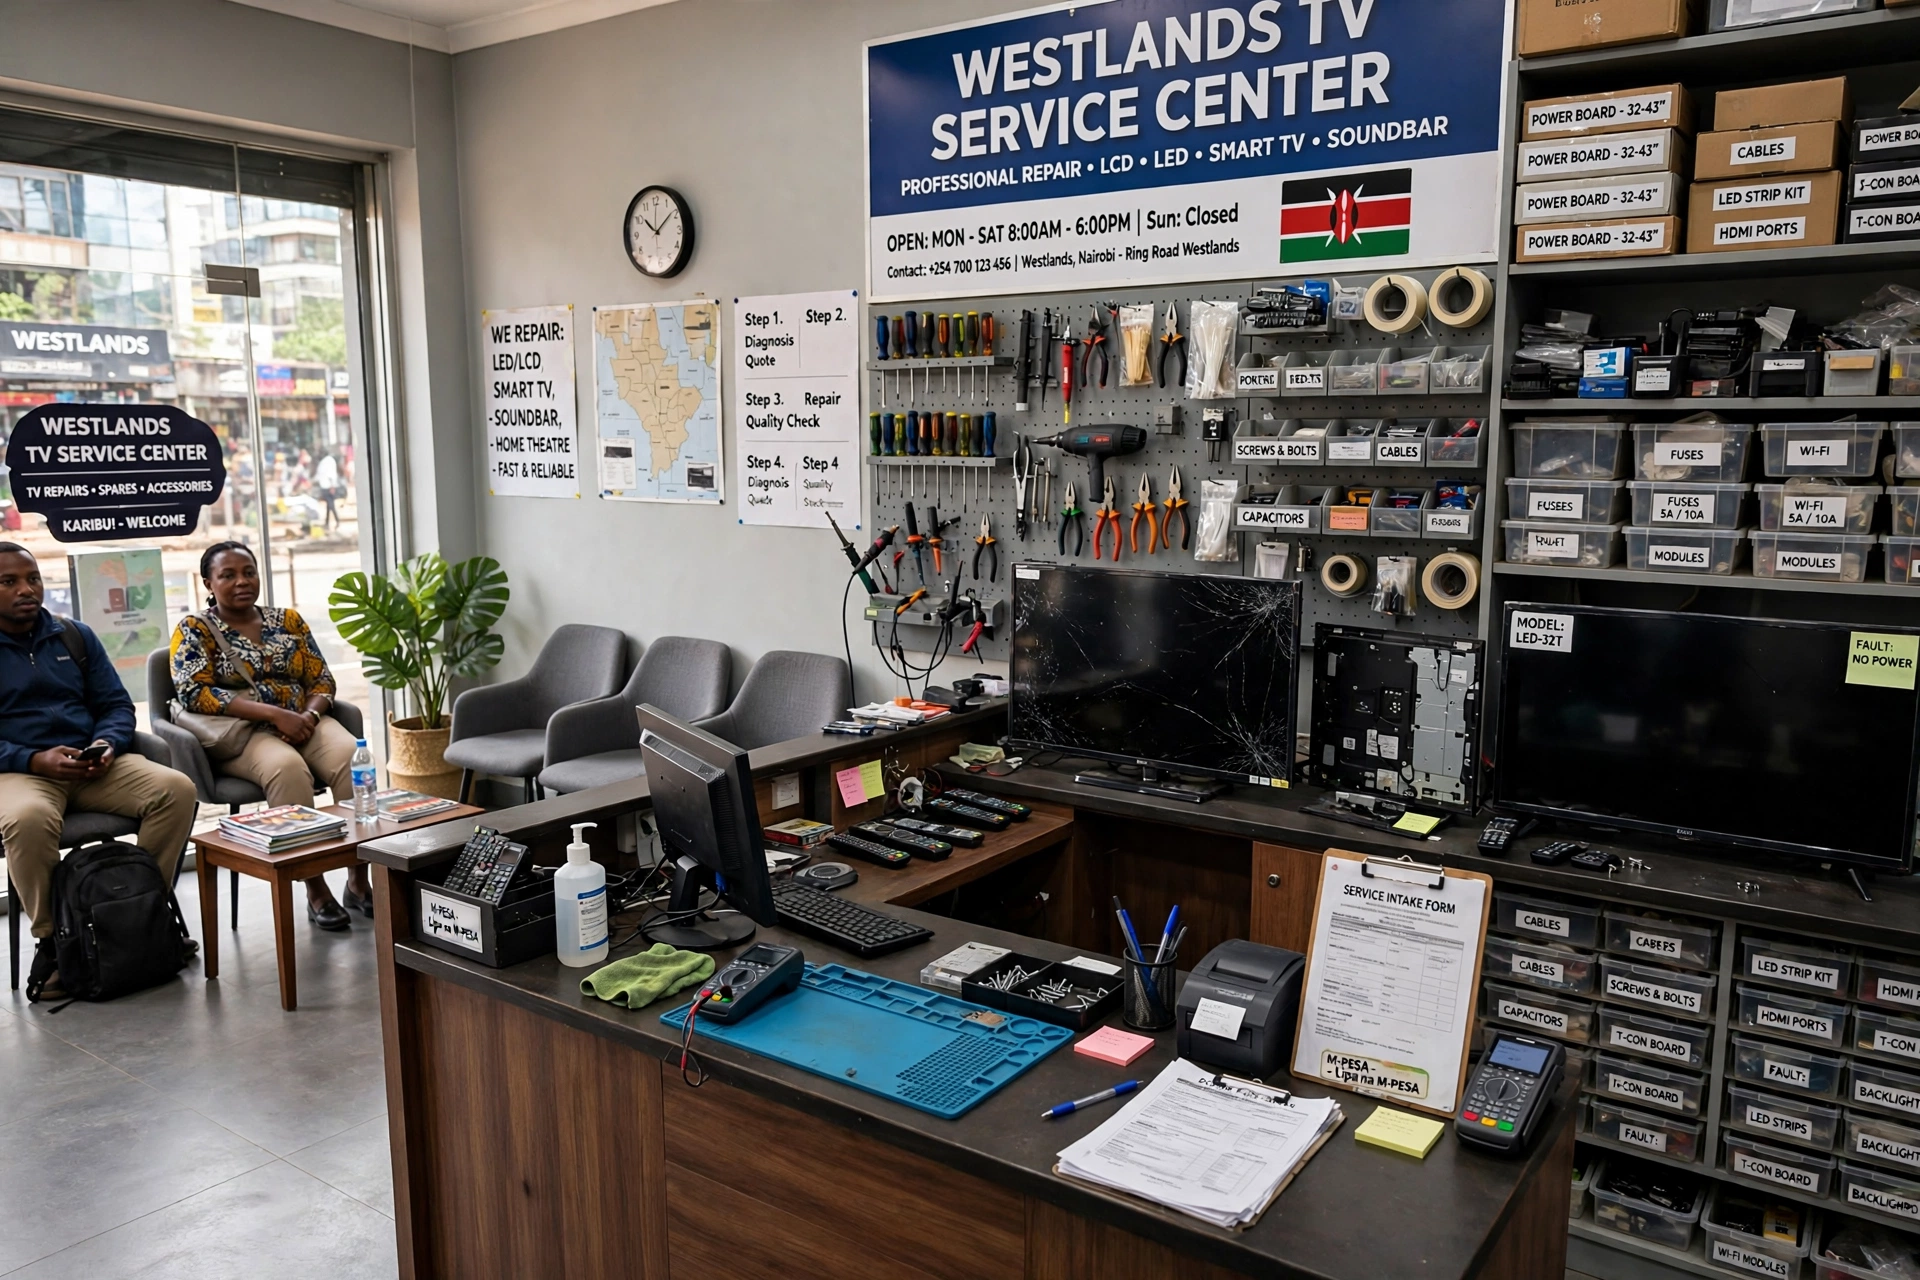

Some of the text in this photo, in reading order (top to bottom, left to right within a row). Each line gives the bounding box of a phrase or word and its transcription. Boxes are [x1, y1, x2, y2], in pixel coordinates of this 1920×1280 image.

[952, 0, 1376, 98] WESTLANDS TV
[931, 51, 1390, 160] SERVICE CENTER
[1532, 110, 1573, 127] POWER
[1576, 107, 1617, 123] BOARD
[1865, 132, 1902, 144] POWER
[901, 116, 1448, 196] PROFESSIONAL REPAIR LCD LED SMART TV SOUNDBAR
[1528, 152, 1569, 167] POWER
[1571, 148, 1611, 164] BOARD
[1737, 143, 1785, 160] CABLES
[1527, 196, 1568, 211] POWER
[1570, 193, 1610, 208] BOARD
[1719, 186, 1806, 207] LED STRIP KIT
[643, 202, 649, 212] 11
[635, 214, 644, 225] 10
[887, 203, 1239, 252] OPEN: MON SAT 8:00AM 6:00PM Sun: Closed
[1856, 214, 1893, 228] T-CON
[1719, 222, 1798, 240] HDMI PORTS
[1529, 234, 1569, 249] POWER
[1571, 232, 1610, 246] BOARD
[887, 238, 1240, 279] Contact: +254 700 123 456 Westlands, Nairobi Ring Road Westlands
[745, 311, 783, 328] Step 1.
[806, 308, 847, 325] Step 2.
[492, 322, 565, 344] WE REPAIR:
[12, 330, 150, 355] WESTLANDS
[745, 333, 794, 351] Diagnosis
[745, 355, 776, 369] Quote
[494, 381, 555, 401] SMART TV,
[746, 392, 841, 409] Step 3. Repair
[41, 417, 171, 436] WESTLANDS
[495, 409, 562, 429] SOUNDBAR,
[746, 413, 820, 431] Quality Check
[496, 437, 571, 453] HOME THEATRE
[1238, 445, 1317, 456] SCREWS & BOLTS
[1380, 447, 1418, 458] CABLES
[1800, 445, 1830, 456] WI-FI
[25, 444, 208, 464] TV SERVICE CENTER
[1671, 449, 1704, 461] FUSES
[498, 462, 575, 479] FAST & RELIABLE
[747, 455, 785, 471] Step 4.
[803, 456, 829, 472] Step
[26, 481, 213, 499] TV REPAIRS SPARES ACCESSORIES
[1667, 496, 1699, 508] FUSES
[1794, 500, 1823, 511] WI-FI
[1243, 511, 1304, 524] CAPACITORS
[1660, 508, 1704, 520] 5A 10A
[1788, 512, 1837, 525] 5A 10A
[63, 513, 186, 533] KARIBU! WELCOME
[1654, 550, 1704, 563] MODULES
[1781, 556, 1836, 569] MODULES
[1517, 617, 1565, 632] MODEL:
[1516, 632, 1563, 647] LED-32T
[1856, 640, 1894, 653] FAULT:
[1852, 654, 1913, 669] NO POWER
[1343, 884, 1456, 915] SERVICE INTAKE FORM
[1524, 915, 1561, 931] CABLES
[1757, 961, 1833, 984] LED STRIP KIT
[1610, 979, 1696, 1008] SCREWS & BOLTS
[1883, 984, 1913, 1000] HDMI
[1504, 1005, 1563, 1027] CAPACITORS
[1761, 1010, 1827, 1032] HDMI PORTS
[1616, 1032, 1686, 1056] T-CON BOARD
[1880, 1036, 1916, 1052] T-CON
[1327, 1054, 1369, 1073] M-PESA
[1769, 1065, 1807, 1082] FAULT:
[1361, 1075, 1374, 1085] na
[1377, 1077, 1420, 1095] M-PESA
[1645, 1087, 1679, 1103] BOARD
[1750, 1112, 1807, 1135] LED STRIPS
[1625, 1128, 1658, 1146] FAULT:
[1741, 1158, 1811, 1186] T-CON BOARD
[1718, 1247, 1786, 1276] WI-FI MODULES
